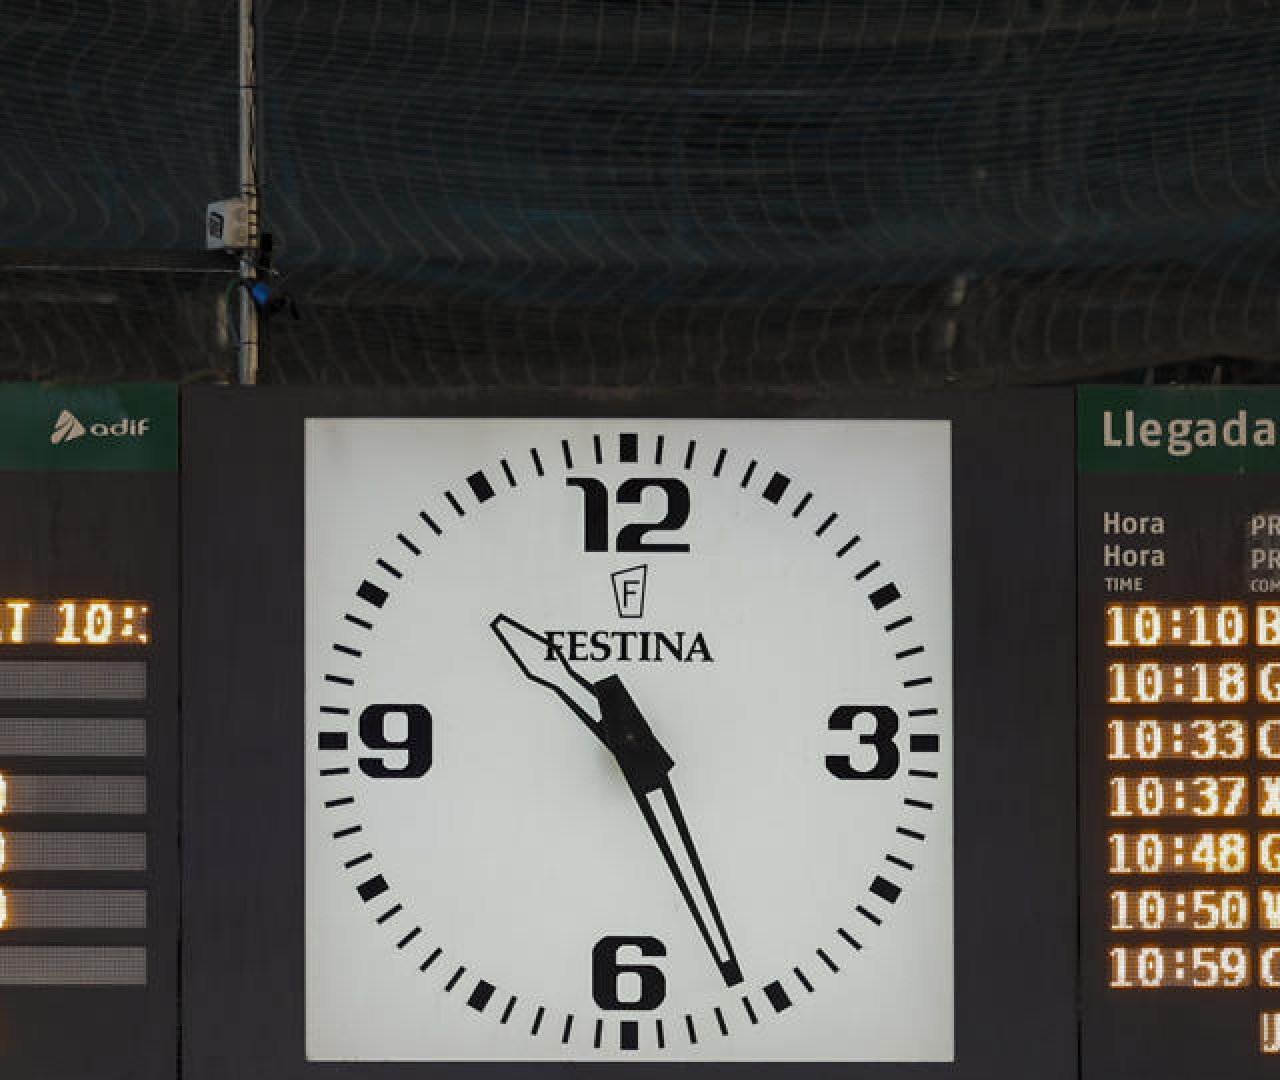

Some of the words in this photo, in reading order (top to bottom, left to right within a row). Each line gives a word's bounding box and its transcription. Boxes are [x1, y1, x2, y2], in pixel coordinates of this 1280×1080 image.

[90, 418, 148, 436] adif
[566, 478, 690, 552] 12
[1104, 512, 1164, 534] Hora
[1104, 544, 1164, 566] Hora
[1104, 578, 1142, 590] TIME
[1108, 606, 1242, 646] 10:10
[543, 631, 714, 663] FESTINA
[1110, 664, 1244, 702] 10:18
[358, 704, 432, 778] 9
[826, 706, 900, 780] 3
[1108, 720, 1244, 758] 10:33
[1110, 778, 1244, 816] 10:37
[1110, 834, 1246, 872] 10:48
[1112, 890, 1246, 928] 10:50
[592, 936, 666, 1010] 6
[1110, 948, 1246, 986] 10:59
